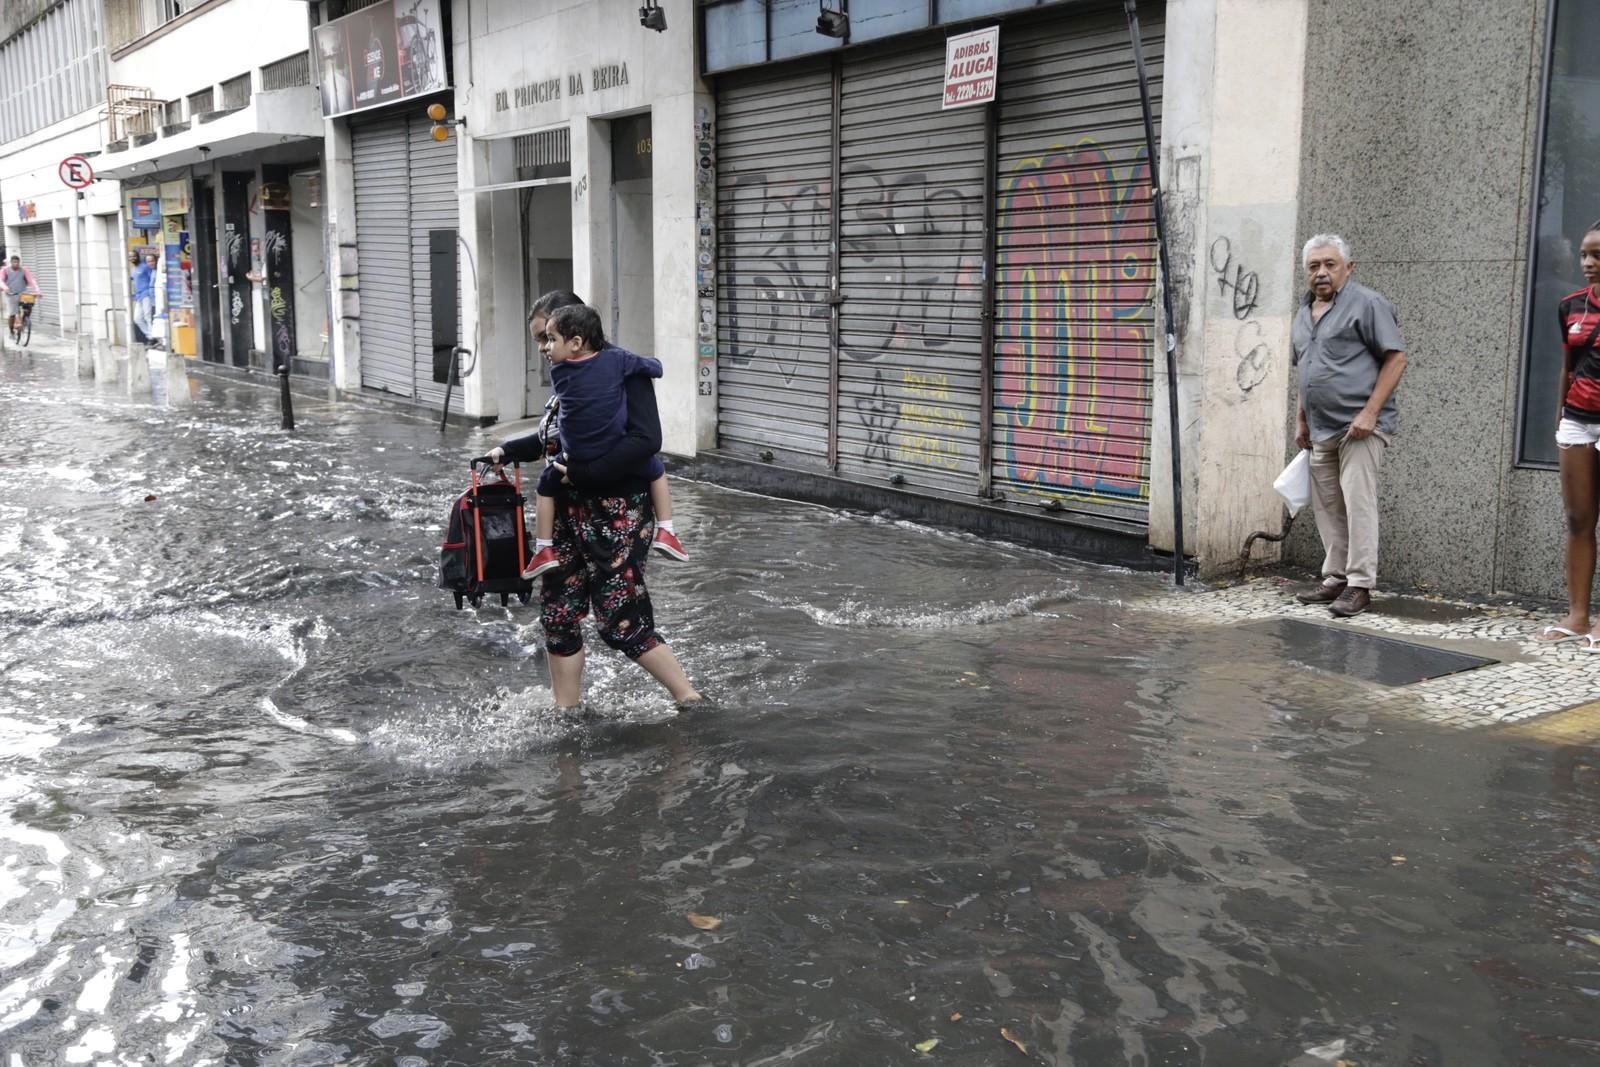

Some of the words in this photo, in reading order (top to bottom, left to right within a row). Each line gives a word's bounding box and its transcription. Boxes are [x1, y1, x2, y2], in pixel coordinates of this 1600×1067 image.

[949, 56, 993, 80] ALUGA
[514, 78, 561, 108] PRINCIPE
[568, 73, 584, 97] DA
[592, 61, 629, 92] BEIRA
[956, 80, 993, 102] 2220-1379
[70, 163, 82, 182] E
[575, 173, 588, 201] 103
